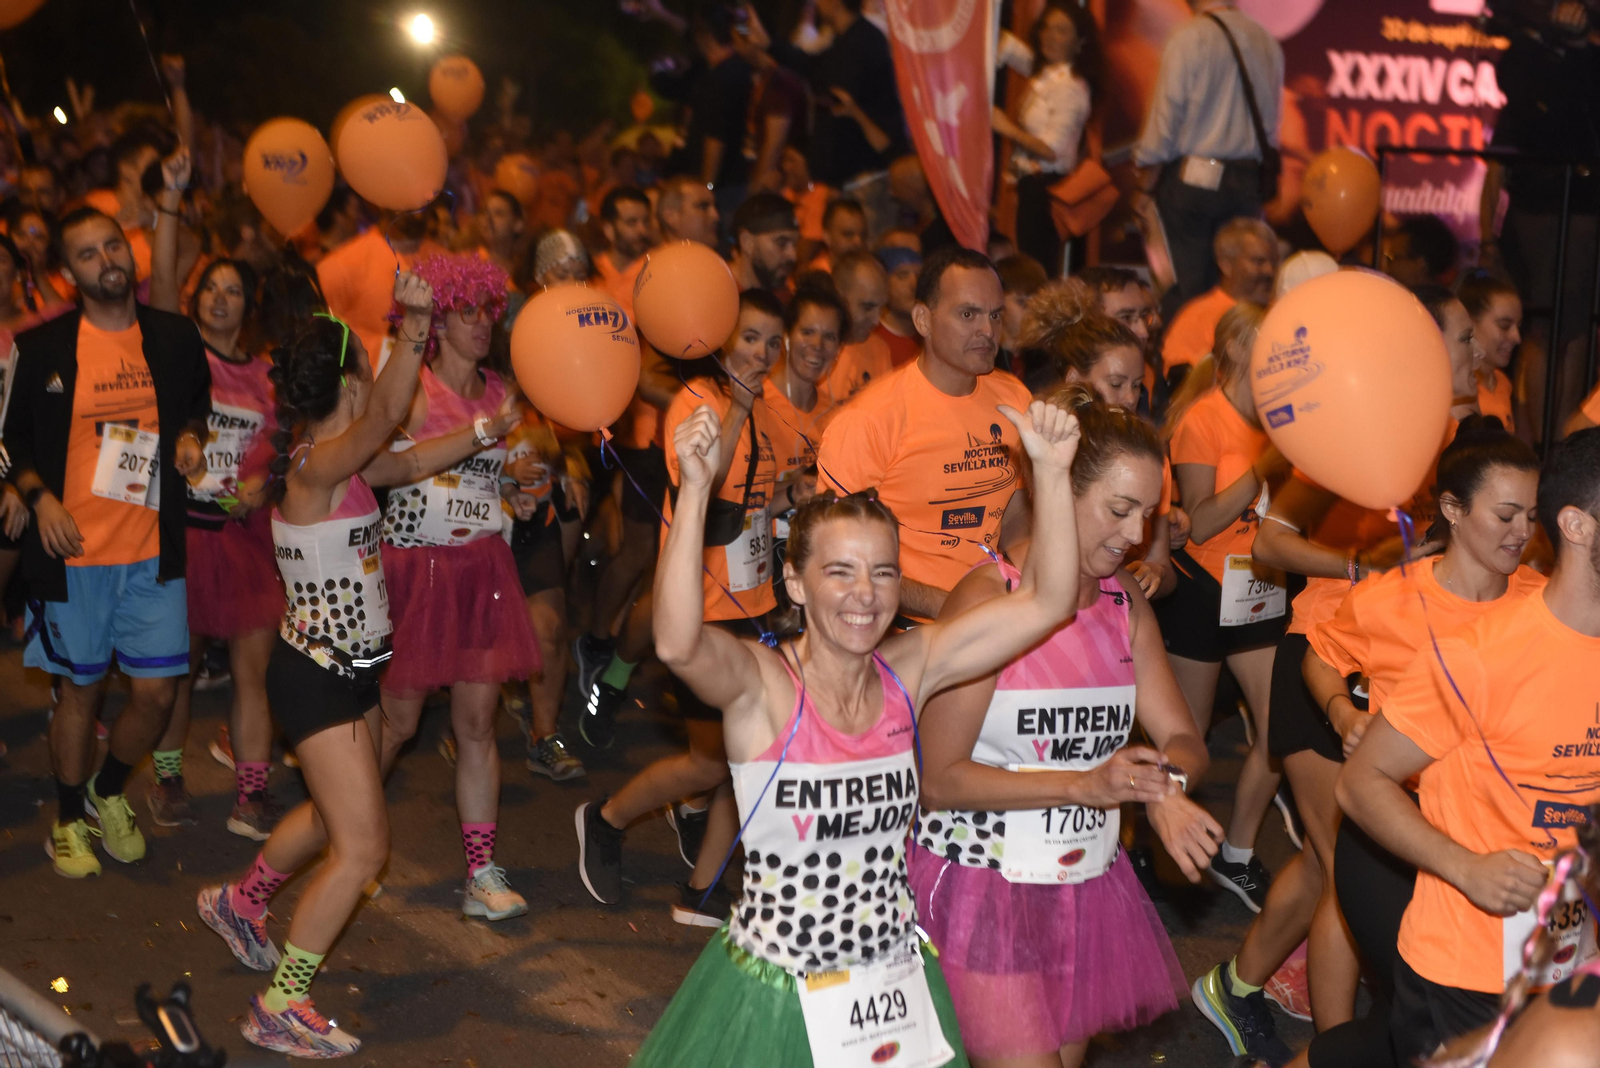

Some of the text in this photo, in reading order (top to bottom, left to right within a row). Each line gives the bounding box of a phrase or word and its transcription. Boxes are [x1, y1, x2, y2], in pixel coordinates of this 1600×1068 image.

[1327, 50, 1447, 104] XXXIV
[565, 306, 606, 316] NOCTURNA
[577, 311, 619, 328] KH7
[943, 459, 987, 474] SEVILLA
[446, 499, 490, 521] 17042
[1017, 703, 1131, 735] ENTRENA
[775, 767, 917, 809] ENTRENA
[850, 989, 908, 1030] 4429
